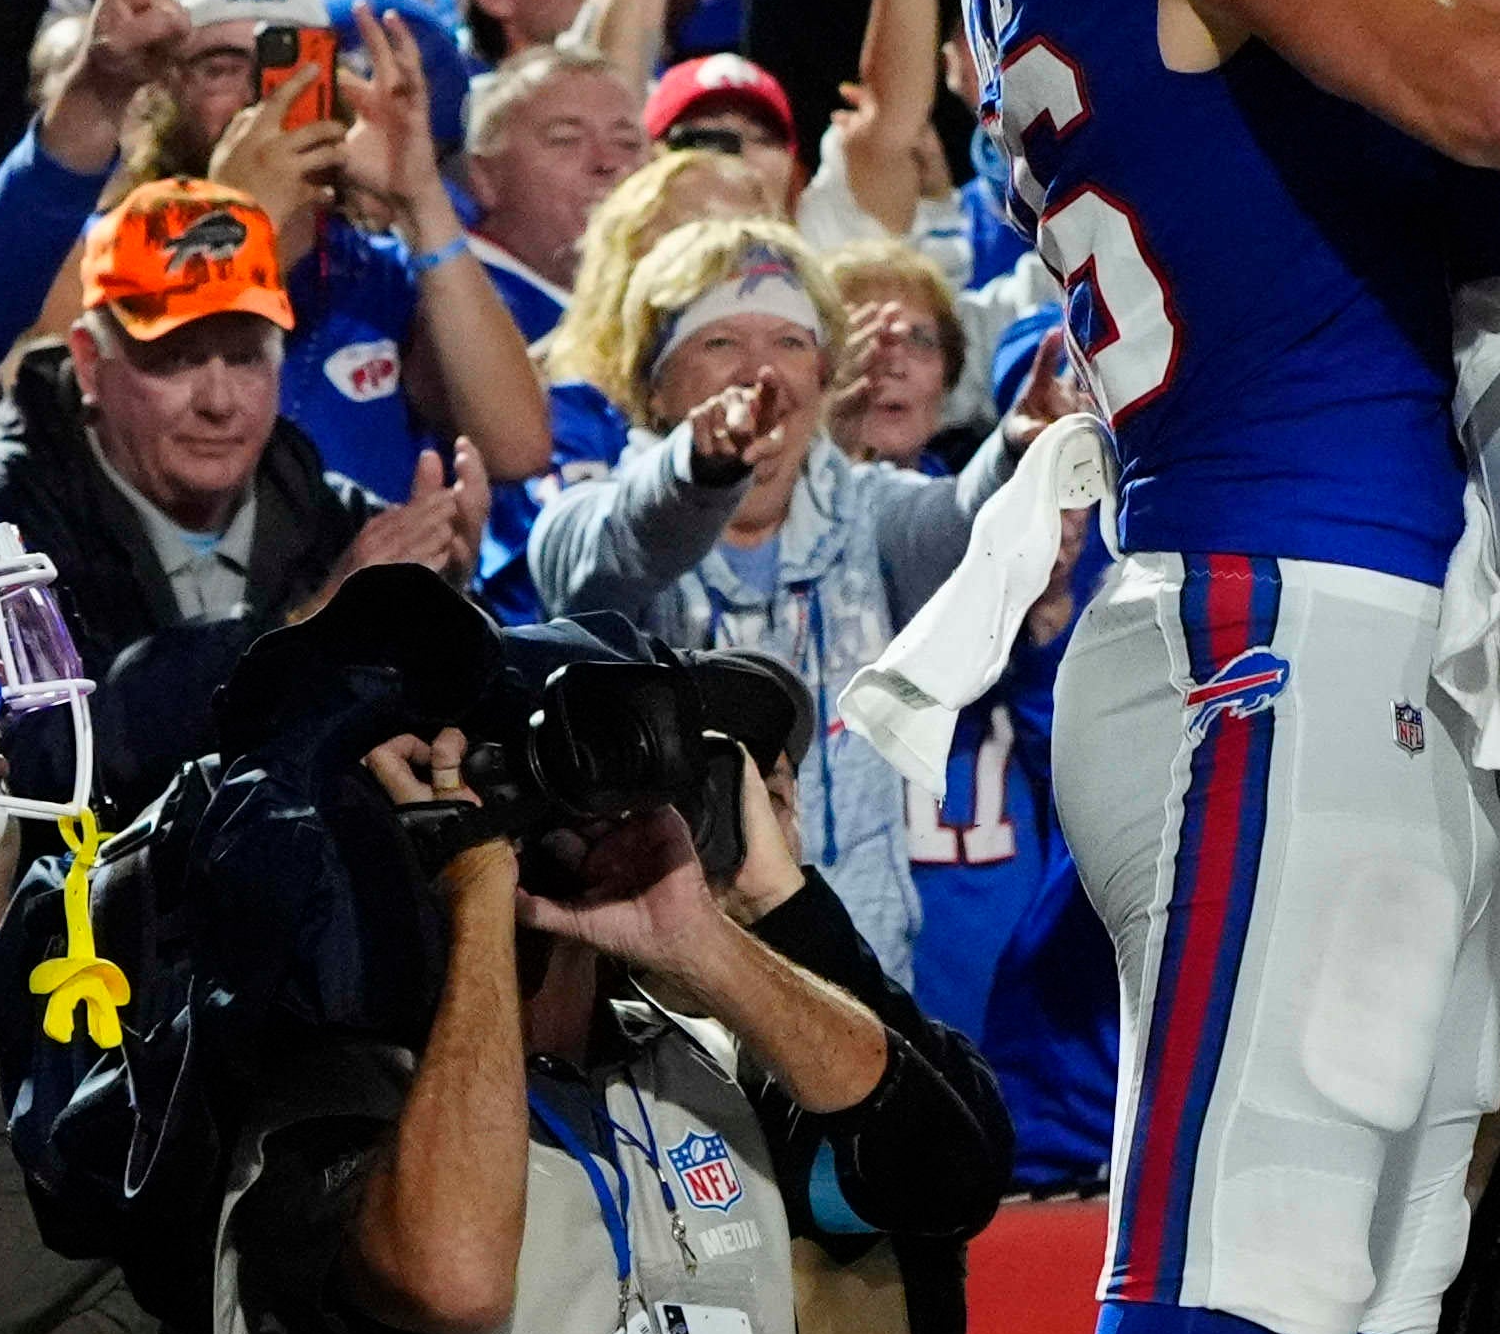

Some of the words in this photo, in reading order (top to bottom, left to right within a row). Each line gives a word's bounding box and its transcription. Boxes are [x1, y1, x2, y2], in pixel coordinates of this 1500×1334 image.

[1397, 721, 1424, 749] NFL
[683, 1161, 738, 1204] NFL
[699, 1219, 763, 1260] MEDIA
